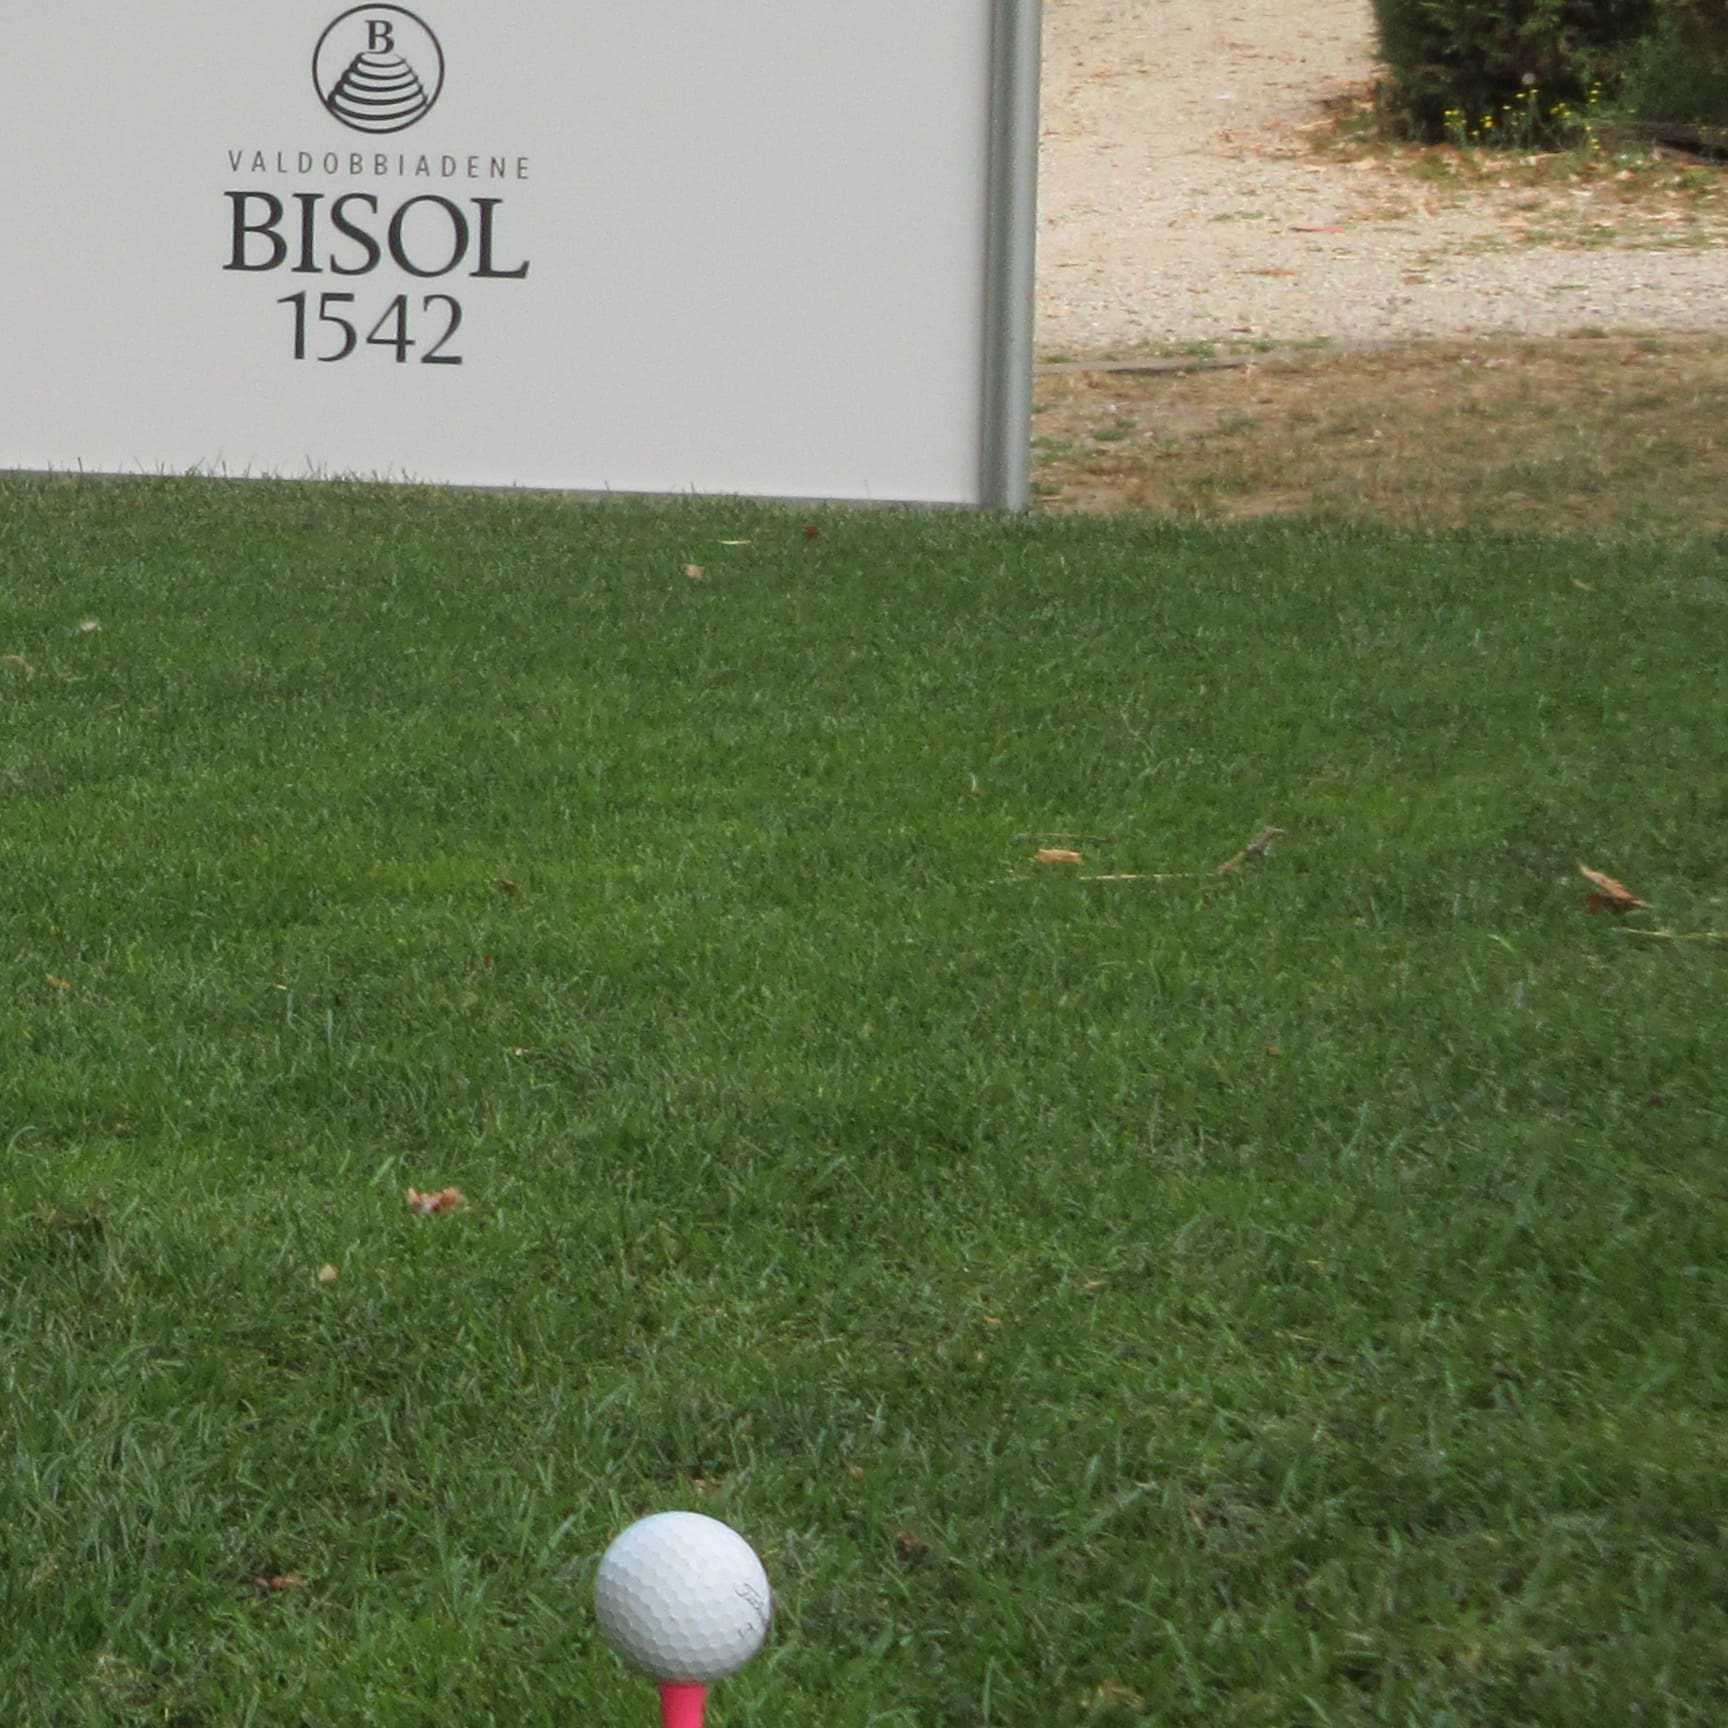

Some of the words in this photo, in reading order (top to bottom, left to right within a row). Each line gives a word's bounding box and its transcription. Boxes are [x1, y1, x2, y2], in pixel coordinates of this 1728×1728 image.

[364, 19, 395, 54] B
[228, 150, 528, 179] VALDOBBIADENE
[222, 191, 530, 279] BISOL
[277, 290, 462, 365] 1542
